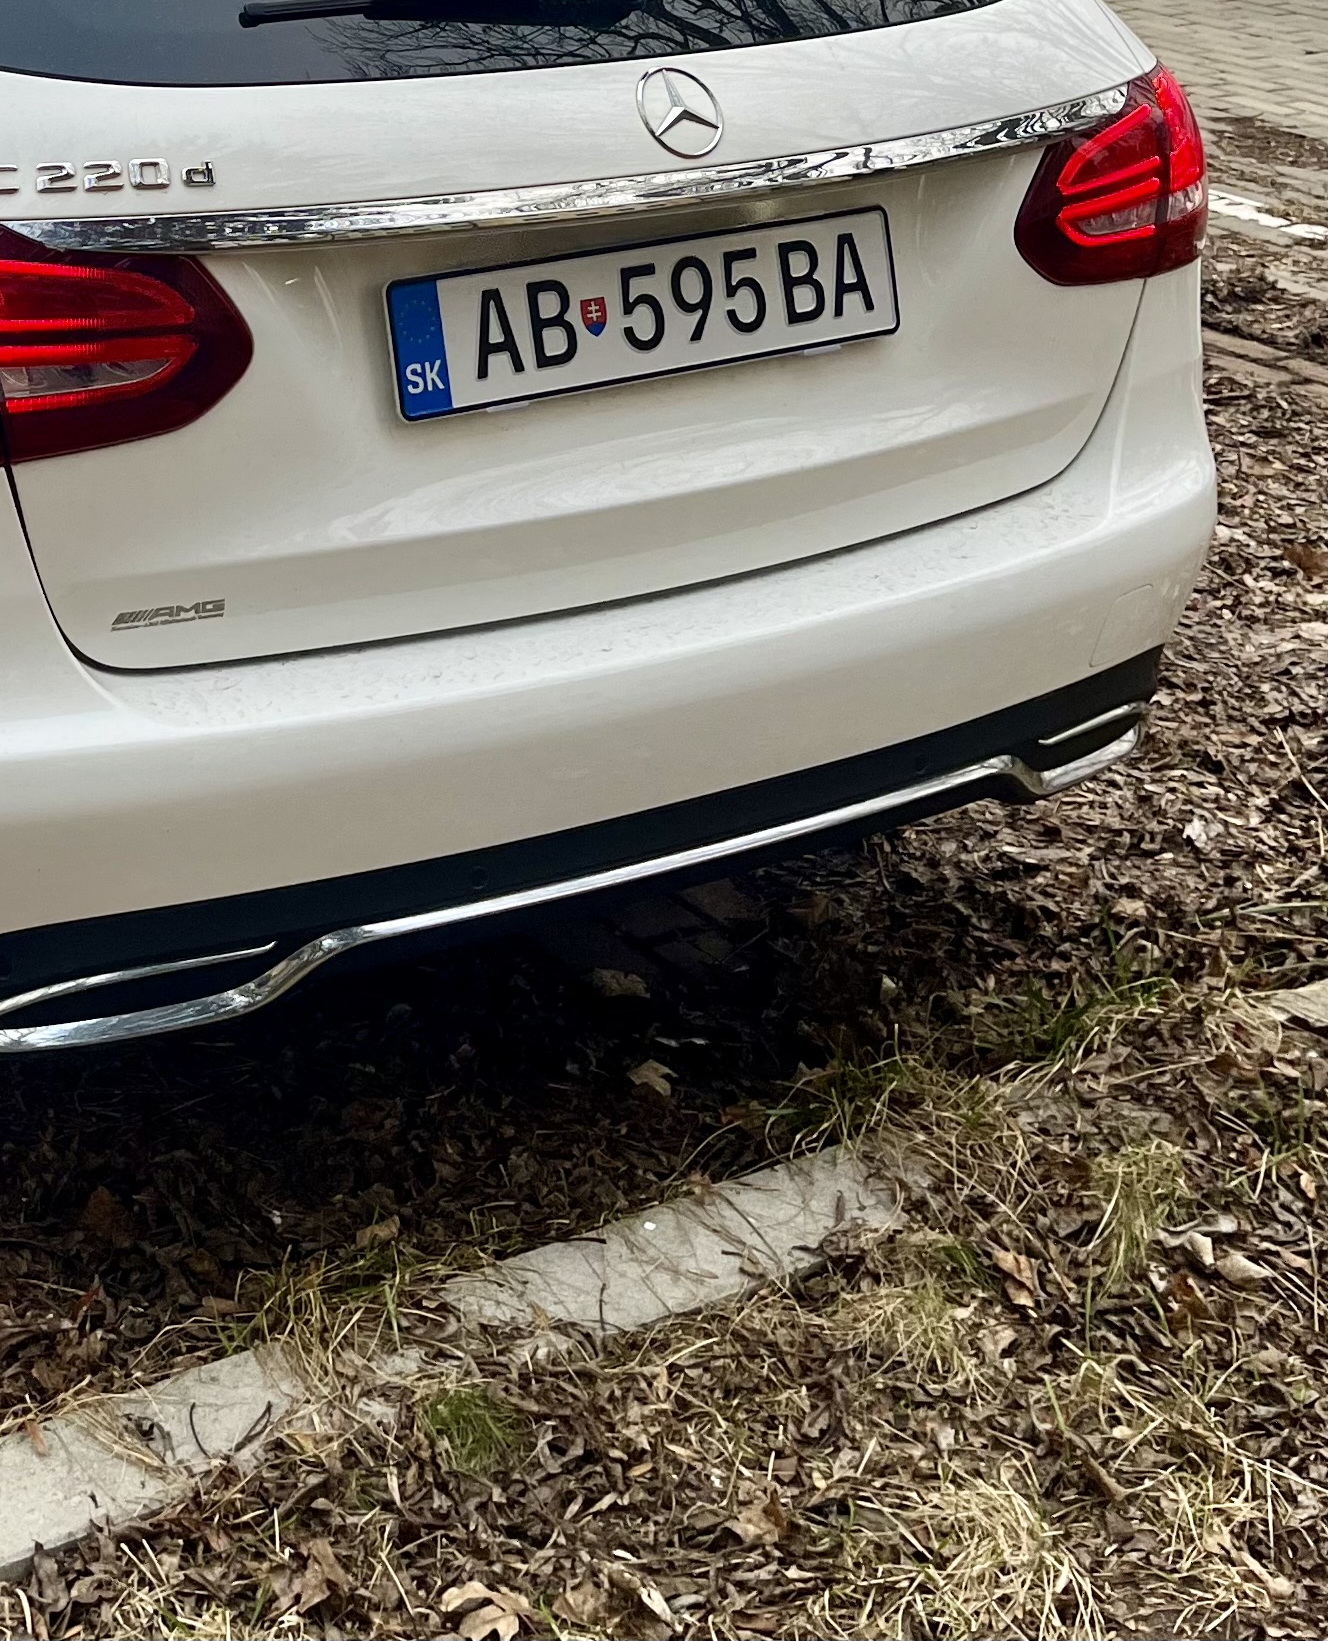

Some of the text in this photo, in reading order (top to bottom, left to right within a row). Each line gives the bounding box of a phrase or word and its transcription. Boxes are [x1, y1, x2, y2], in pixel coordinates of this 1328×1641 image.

[35, 157, 172, 193] 220
[180, 159, 217, 188] d
[476, 231, 875, 380] AB 595BA
[405, 359, 445, 395] SK
[147, 598, 226, 621] AMG
